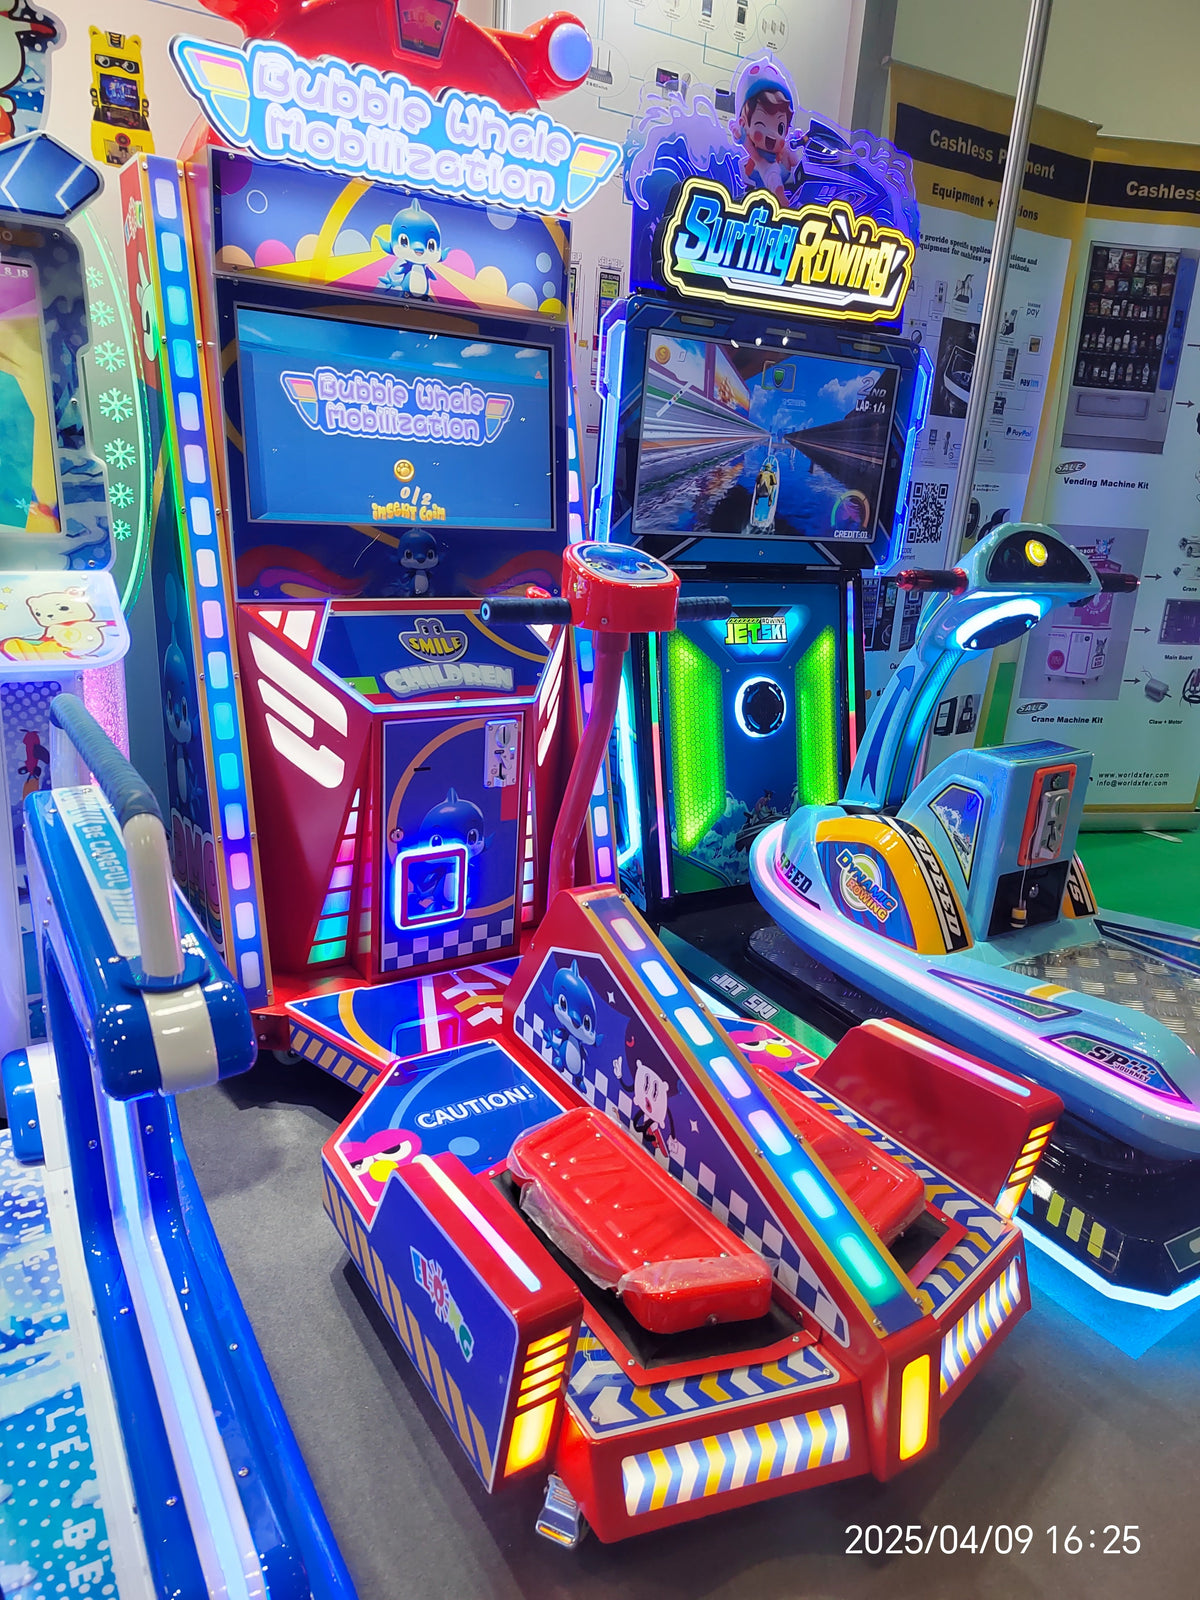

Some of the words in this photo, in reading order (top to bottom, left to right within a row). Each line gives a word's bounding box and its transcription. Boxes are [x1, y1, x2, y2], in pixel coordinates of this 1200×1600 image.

[252, 52, 432, 135] Bubble
[446, 98, 572, 167] Whale
[265, 104, 557, 207] Mobilization
[930, 128, 994, 162] Cashless
[997, 147, 1056, 180] Pment
[931, 182, 985, 209] Equipment
[675, 195, 799, 286] Surfing
[924, 234, 949, 246] provide
[949, 239, 969, 250] specific
[951, 247, 960, 256] for
[1027, 258, 1038, 266] and
[317, 372, 408, 407] Bubble
[415, 383, 485, 415] Whale
[857, 376, 887, 399] 2ND
[325, 401, 480, 441] Mobilization
[1012, 429, 1032, 438] PayPal
[1056, 463, 1083, 472] SALE
[1063, 477, 1098, 488] Vending
[1100, 479, 1136, 489] Machine
[1137, 481, 1149, 490] Kit
[725, 622, 761, 645] JET
[761, 624, 787, 640] SKI
[408, 637, 463, 656] SMILE
[384, 663, 514, 694] CHILDREN
[1018, 702, 1045, 713] SALE
[1031, 716, 1055, 724] Crane
[1057, 716, 1090, 724] Machine
[1092, 716, 1104, 724] Kit
[1096, 779, 1168, 787] info@worldxfer.com
[79, 825, 104, 840] BE
[89, 837, 129, 888] CAREFUL
[778, 852, 813, 894] SPEED
[836, 849, 898, 911] DYNAMIC
[908, 834, 962, 938] SPEED
[846, 878, 889, 922] ROWING
[1114, 1062, 1150, 1082] JOURNEY
[416, 1084, 535, 1129] CAUTION!
